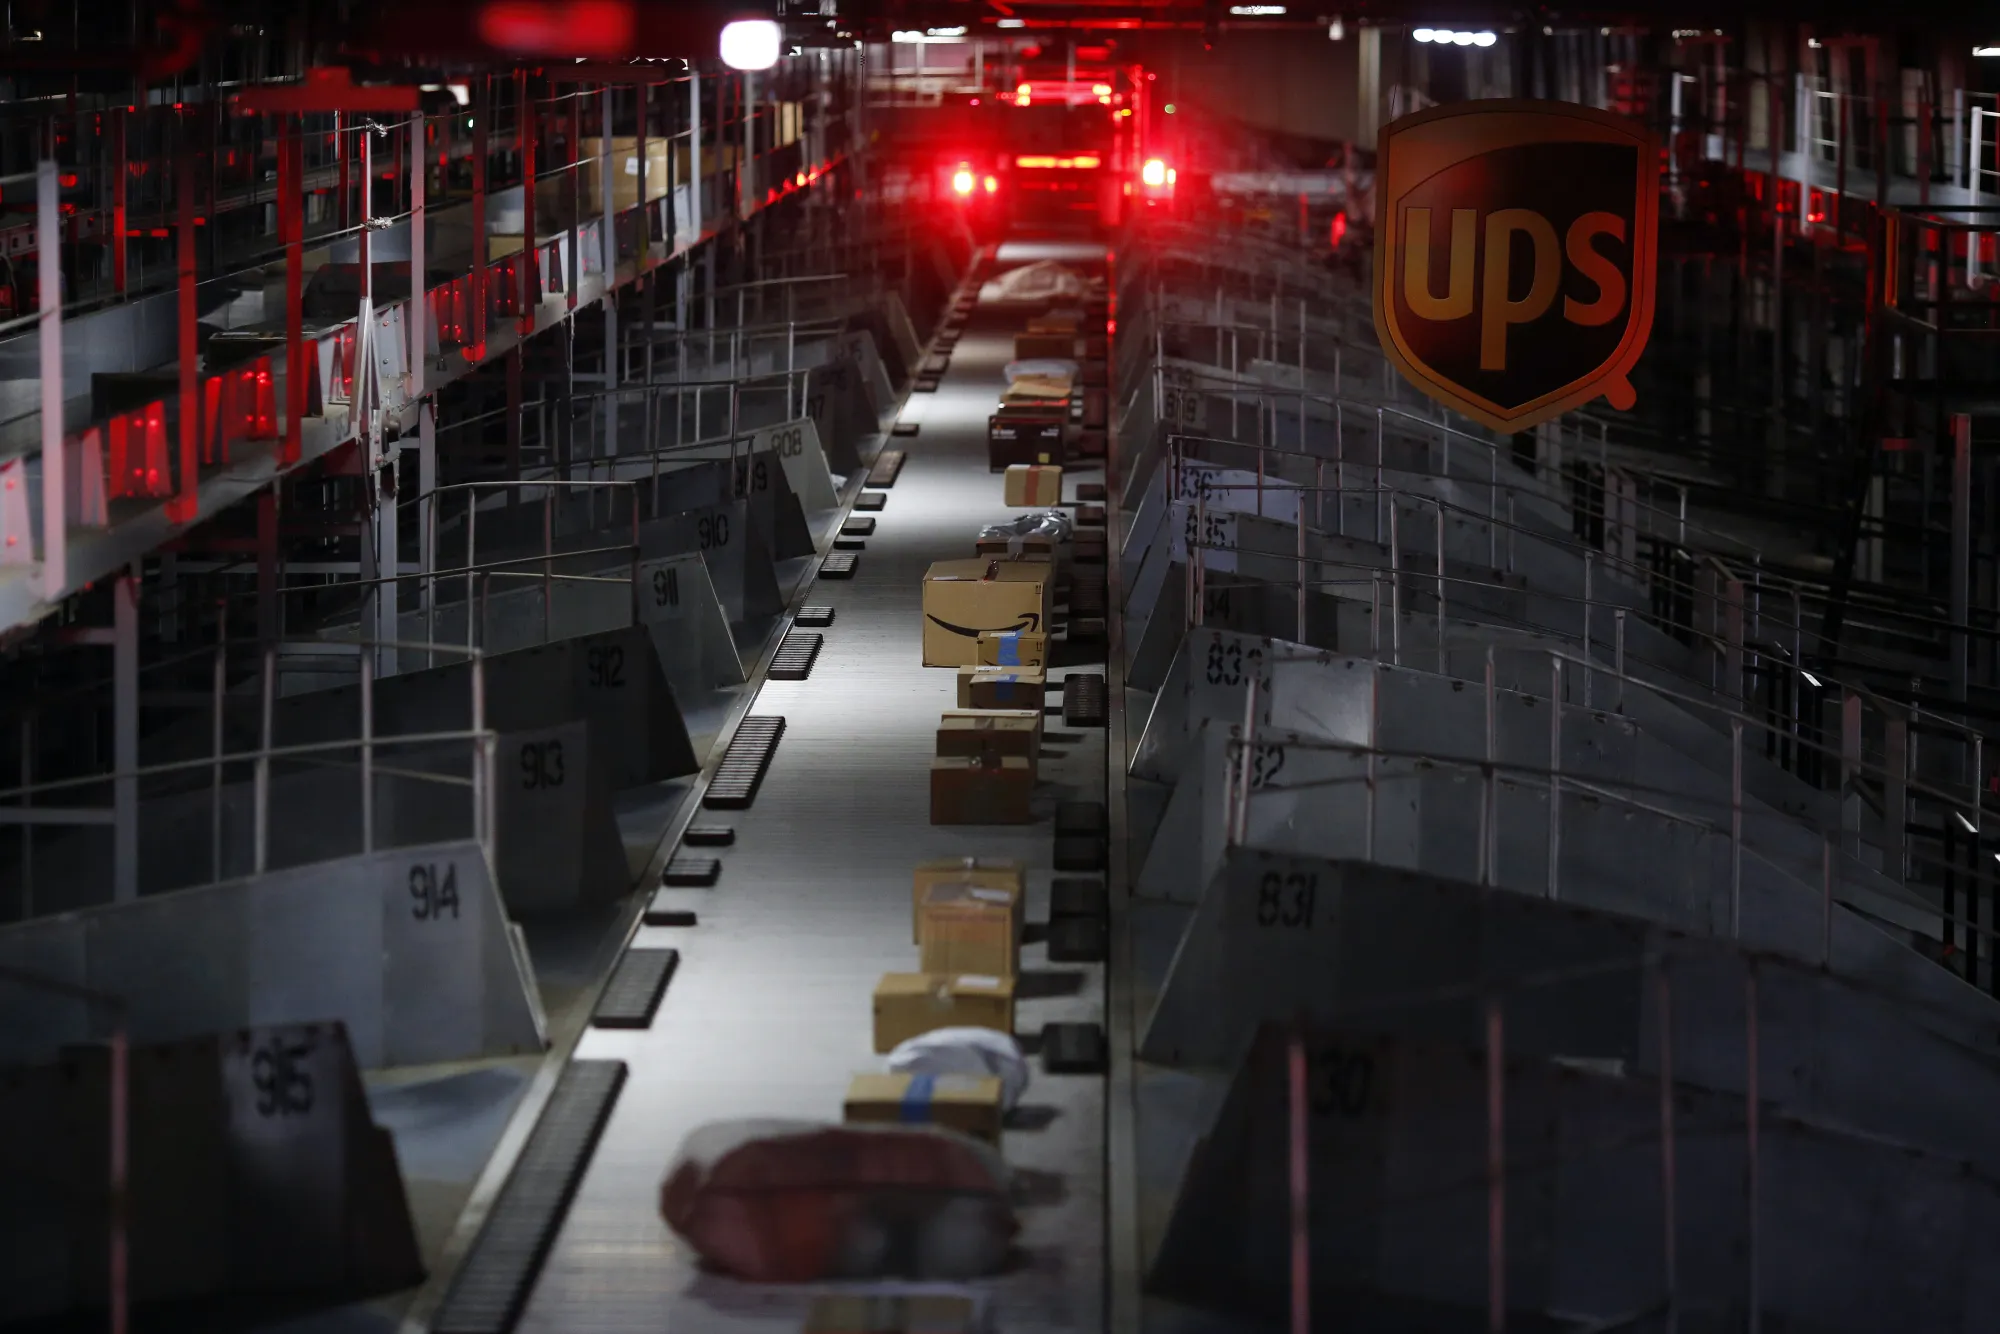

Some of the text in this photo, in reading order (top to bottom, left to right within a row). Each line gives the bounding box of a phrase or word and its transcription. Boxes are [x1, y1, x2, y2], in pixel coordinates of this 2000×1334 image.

[1404, 206, 1627, 371] ups
[771, 428, 803, 458] 908
[698, 514, 729, 549] 910
[653, 568, 679, 606] 911
[588, 645, 625, 688] 912
[520, 740, 564, 789] 913
[409, 862, 460, 920] 914
[1258, 872, 1317, 929] 831
[253, 1041, 314, 1117] 915
[1313, 1046, 1374, 1118] 30
